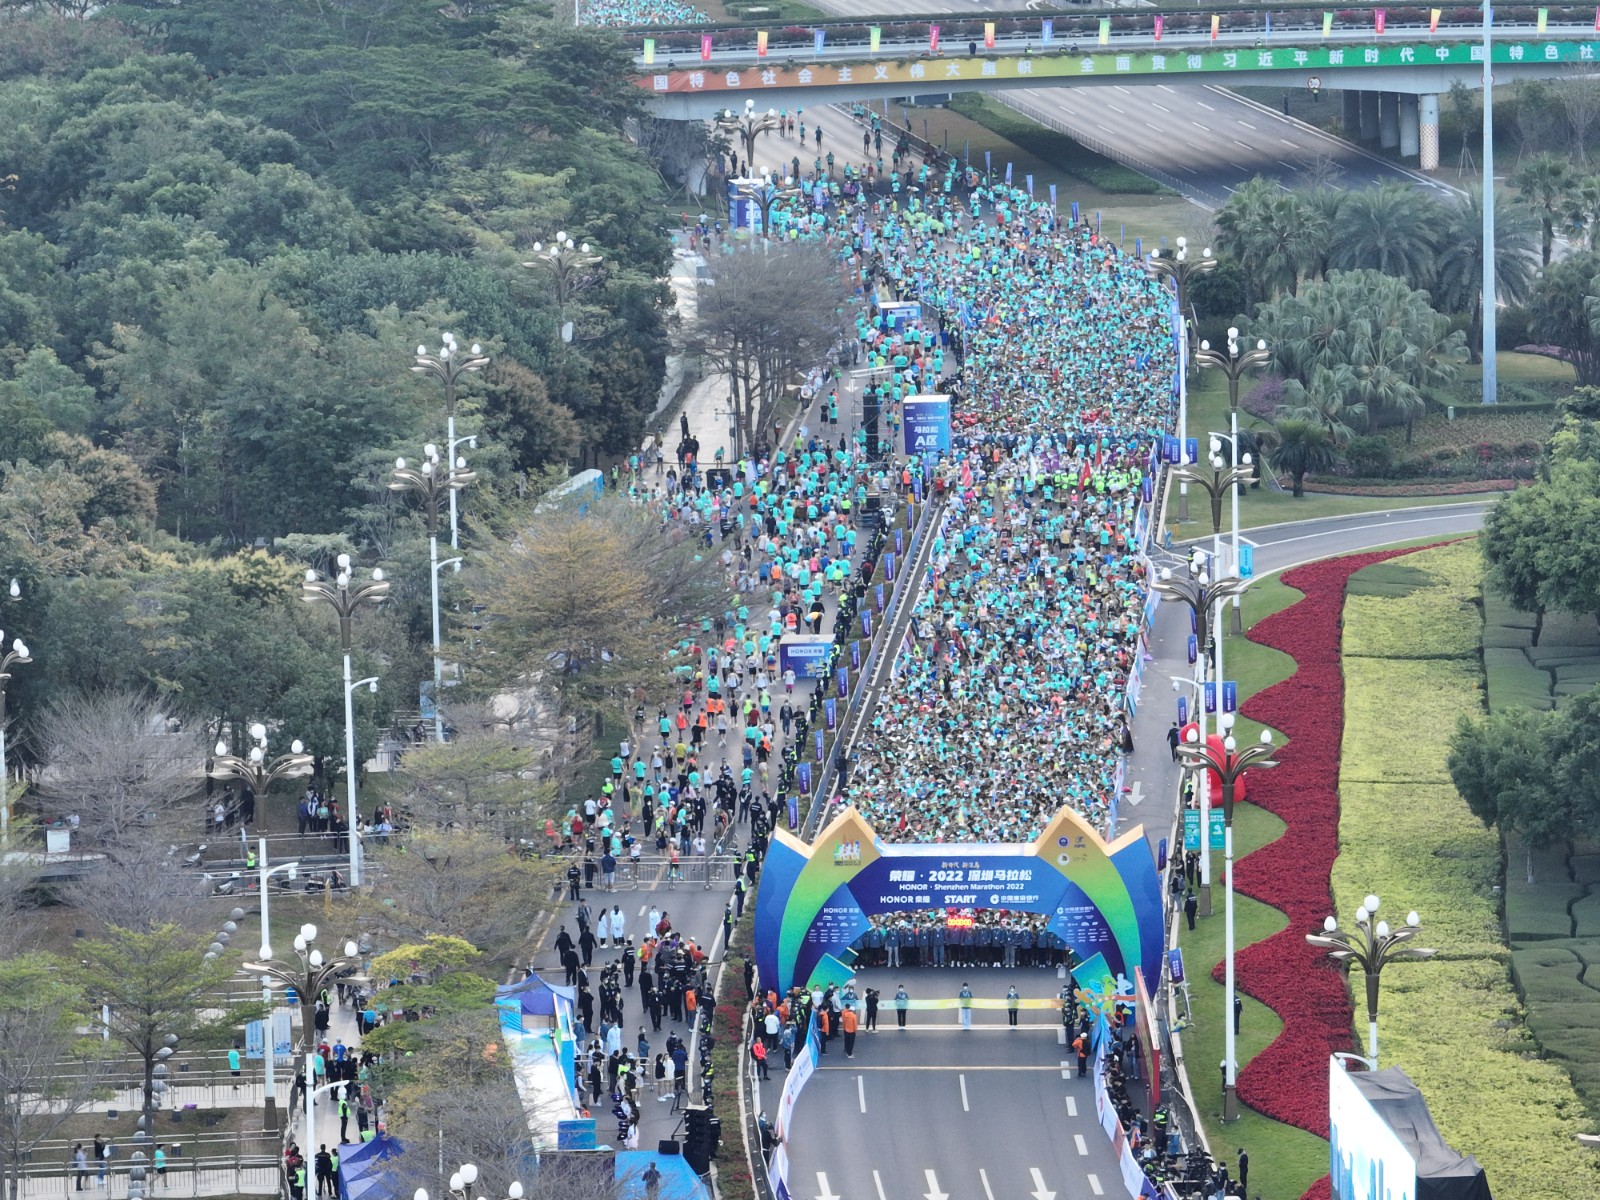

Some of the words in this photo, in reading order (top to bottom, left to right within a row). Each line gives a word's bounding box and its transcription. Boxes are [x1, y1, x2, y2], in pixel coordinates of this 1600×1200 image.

[928, 870, 964, 882] 2022
[967, 869, 1032, 881] 深圳马拉松
[880, 895, 914, 903] HONOR
[944, 895, 977, 904] START
